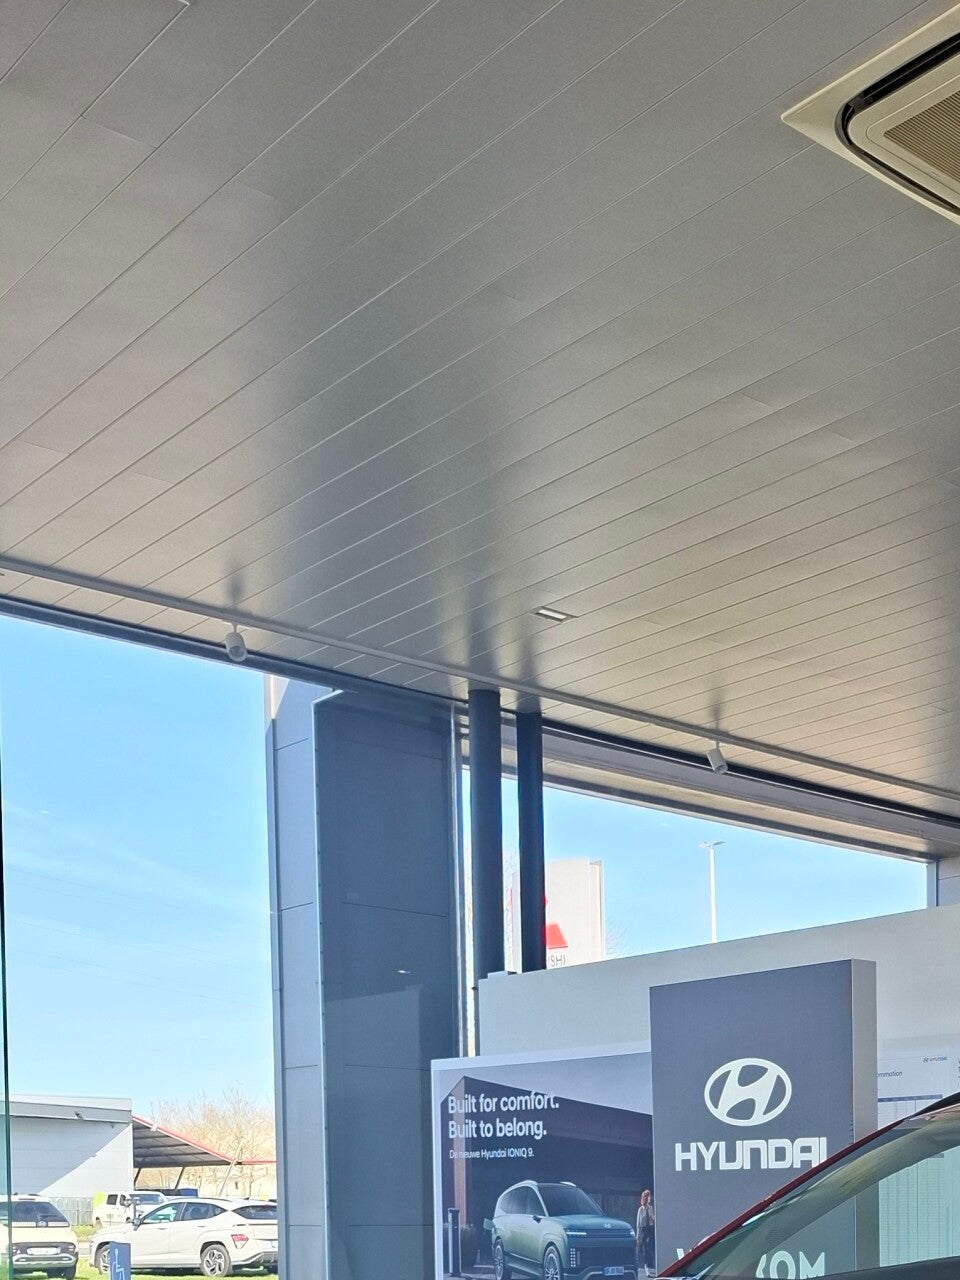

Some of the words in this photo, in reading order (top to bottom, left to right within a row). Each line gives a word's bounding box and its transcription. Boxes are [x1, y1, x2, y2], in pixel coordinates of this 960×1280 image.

[448, 1094, 477, 1114] Built
[479, 1093, 498, 1113] for
[500, 1091, 560, 1112] comfort.
[448, 1119, 477, 1139] Built
[479, 1120, 494, 1138] to
[496, 1117, 547, 1140] belong.
[449, 1149, 458, 1159] De
[481, 1147, 507, 1160] Hyundai
[507, 1147, 528, 1158] IONIQ
[675, 1137, 828, 1171] HYUNDAI
